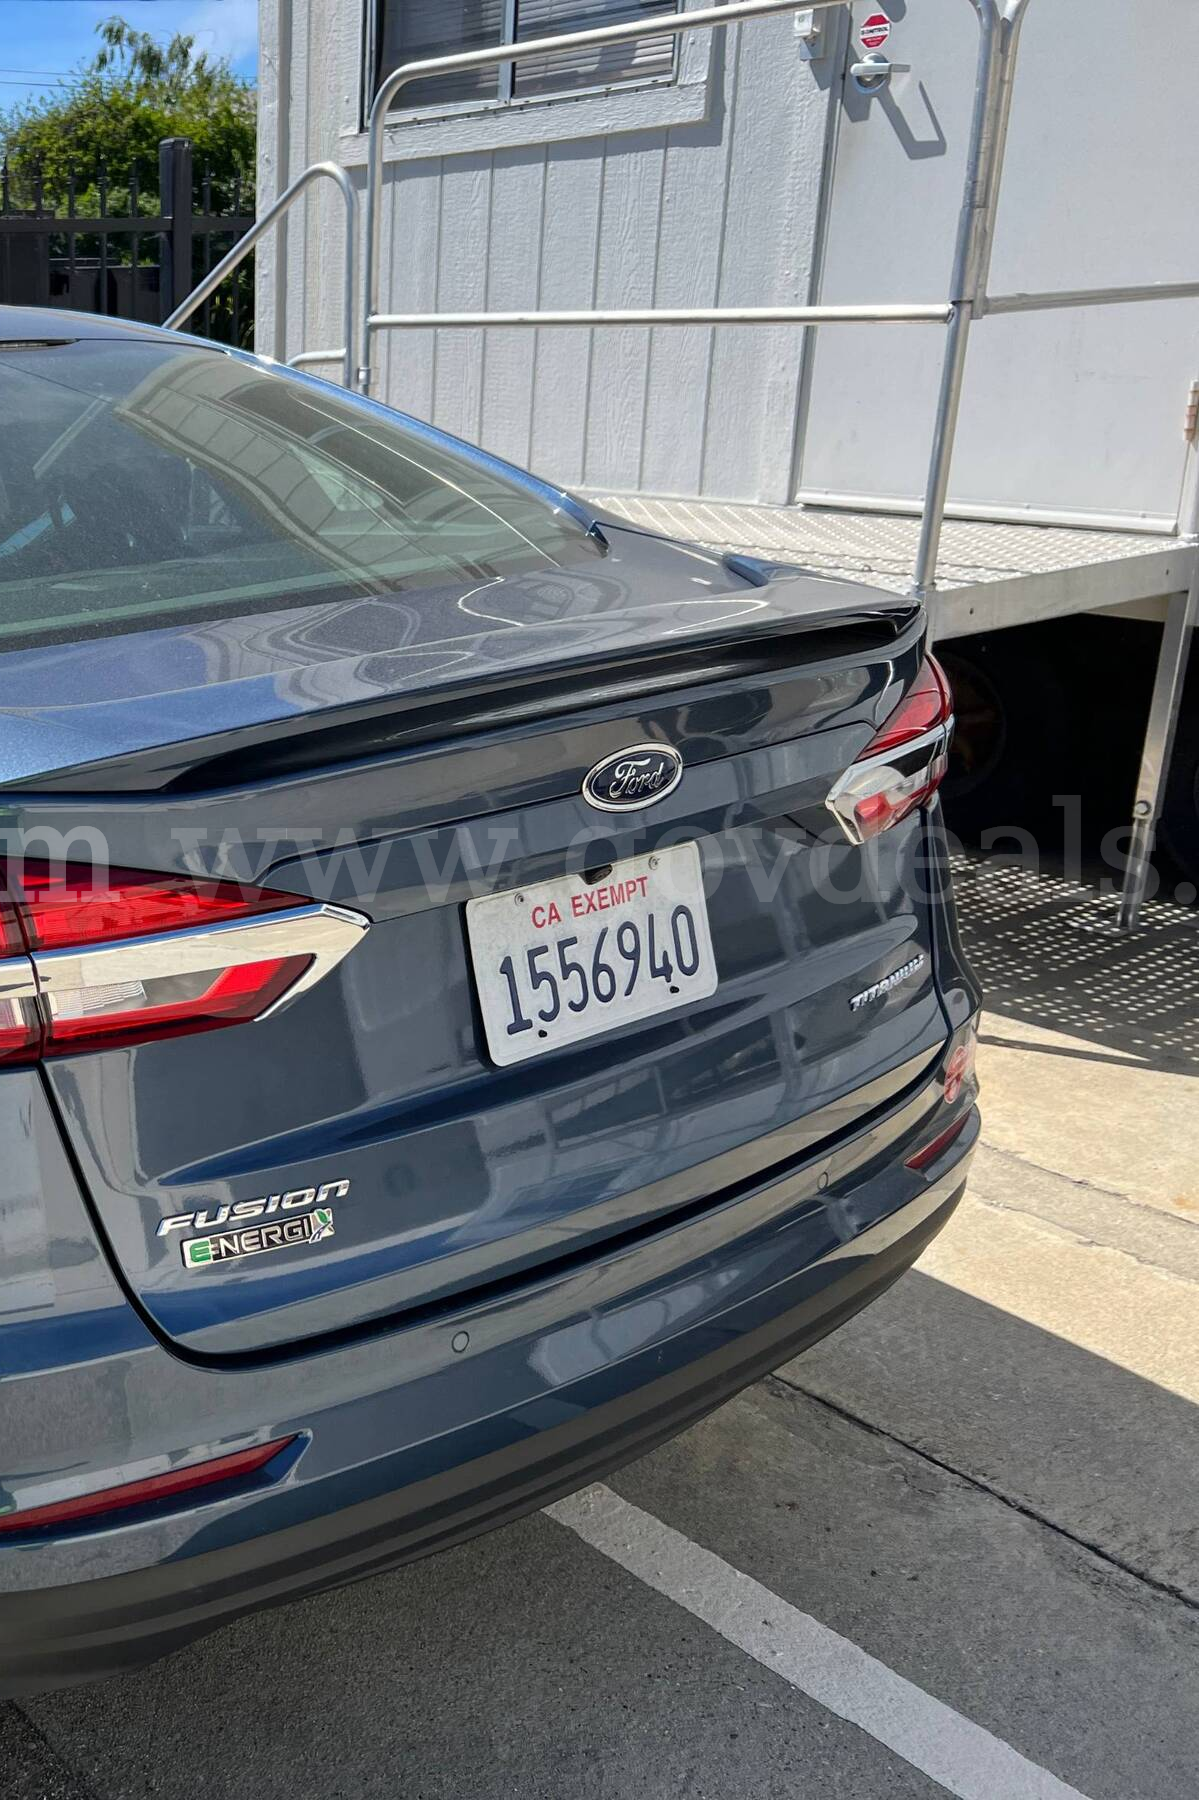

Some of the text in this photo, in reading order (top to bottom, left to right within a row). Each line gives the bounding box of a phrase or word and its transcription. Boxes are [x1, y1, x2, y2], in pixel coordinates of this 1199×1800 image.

[609, 758, 665, 799] Ford
[531, 875, 649, 930] CA EXEMPT
[499, 903, 700, 1036] 1556940
[155, 1178, 351, 1238] FUSION
[189, 1216, 311, 1264] ENERGI
